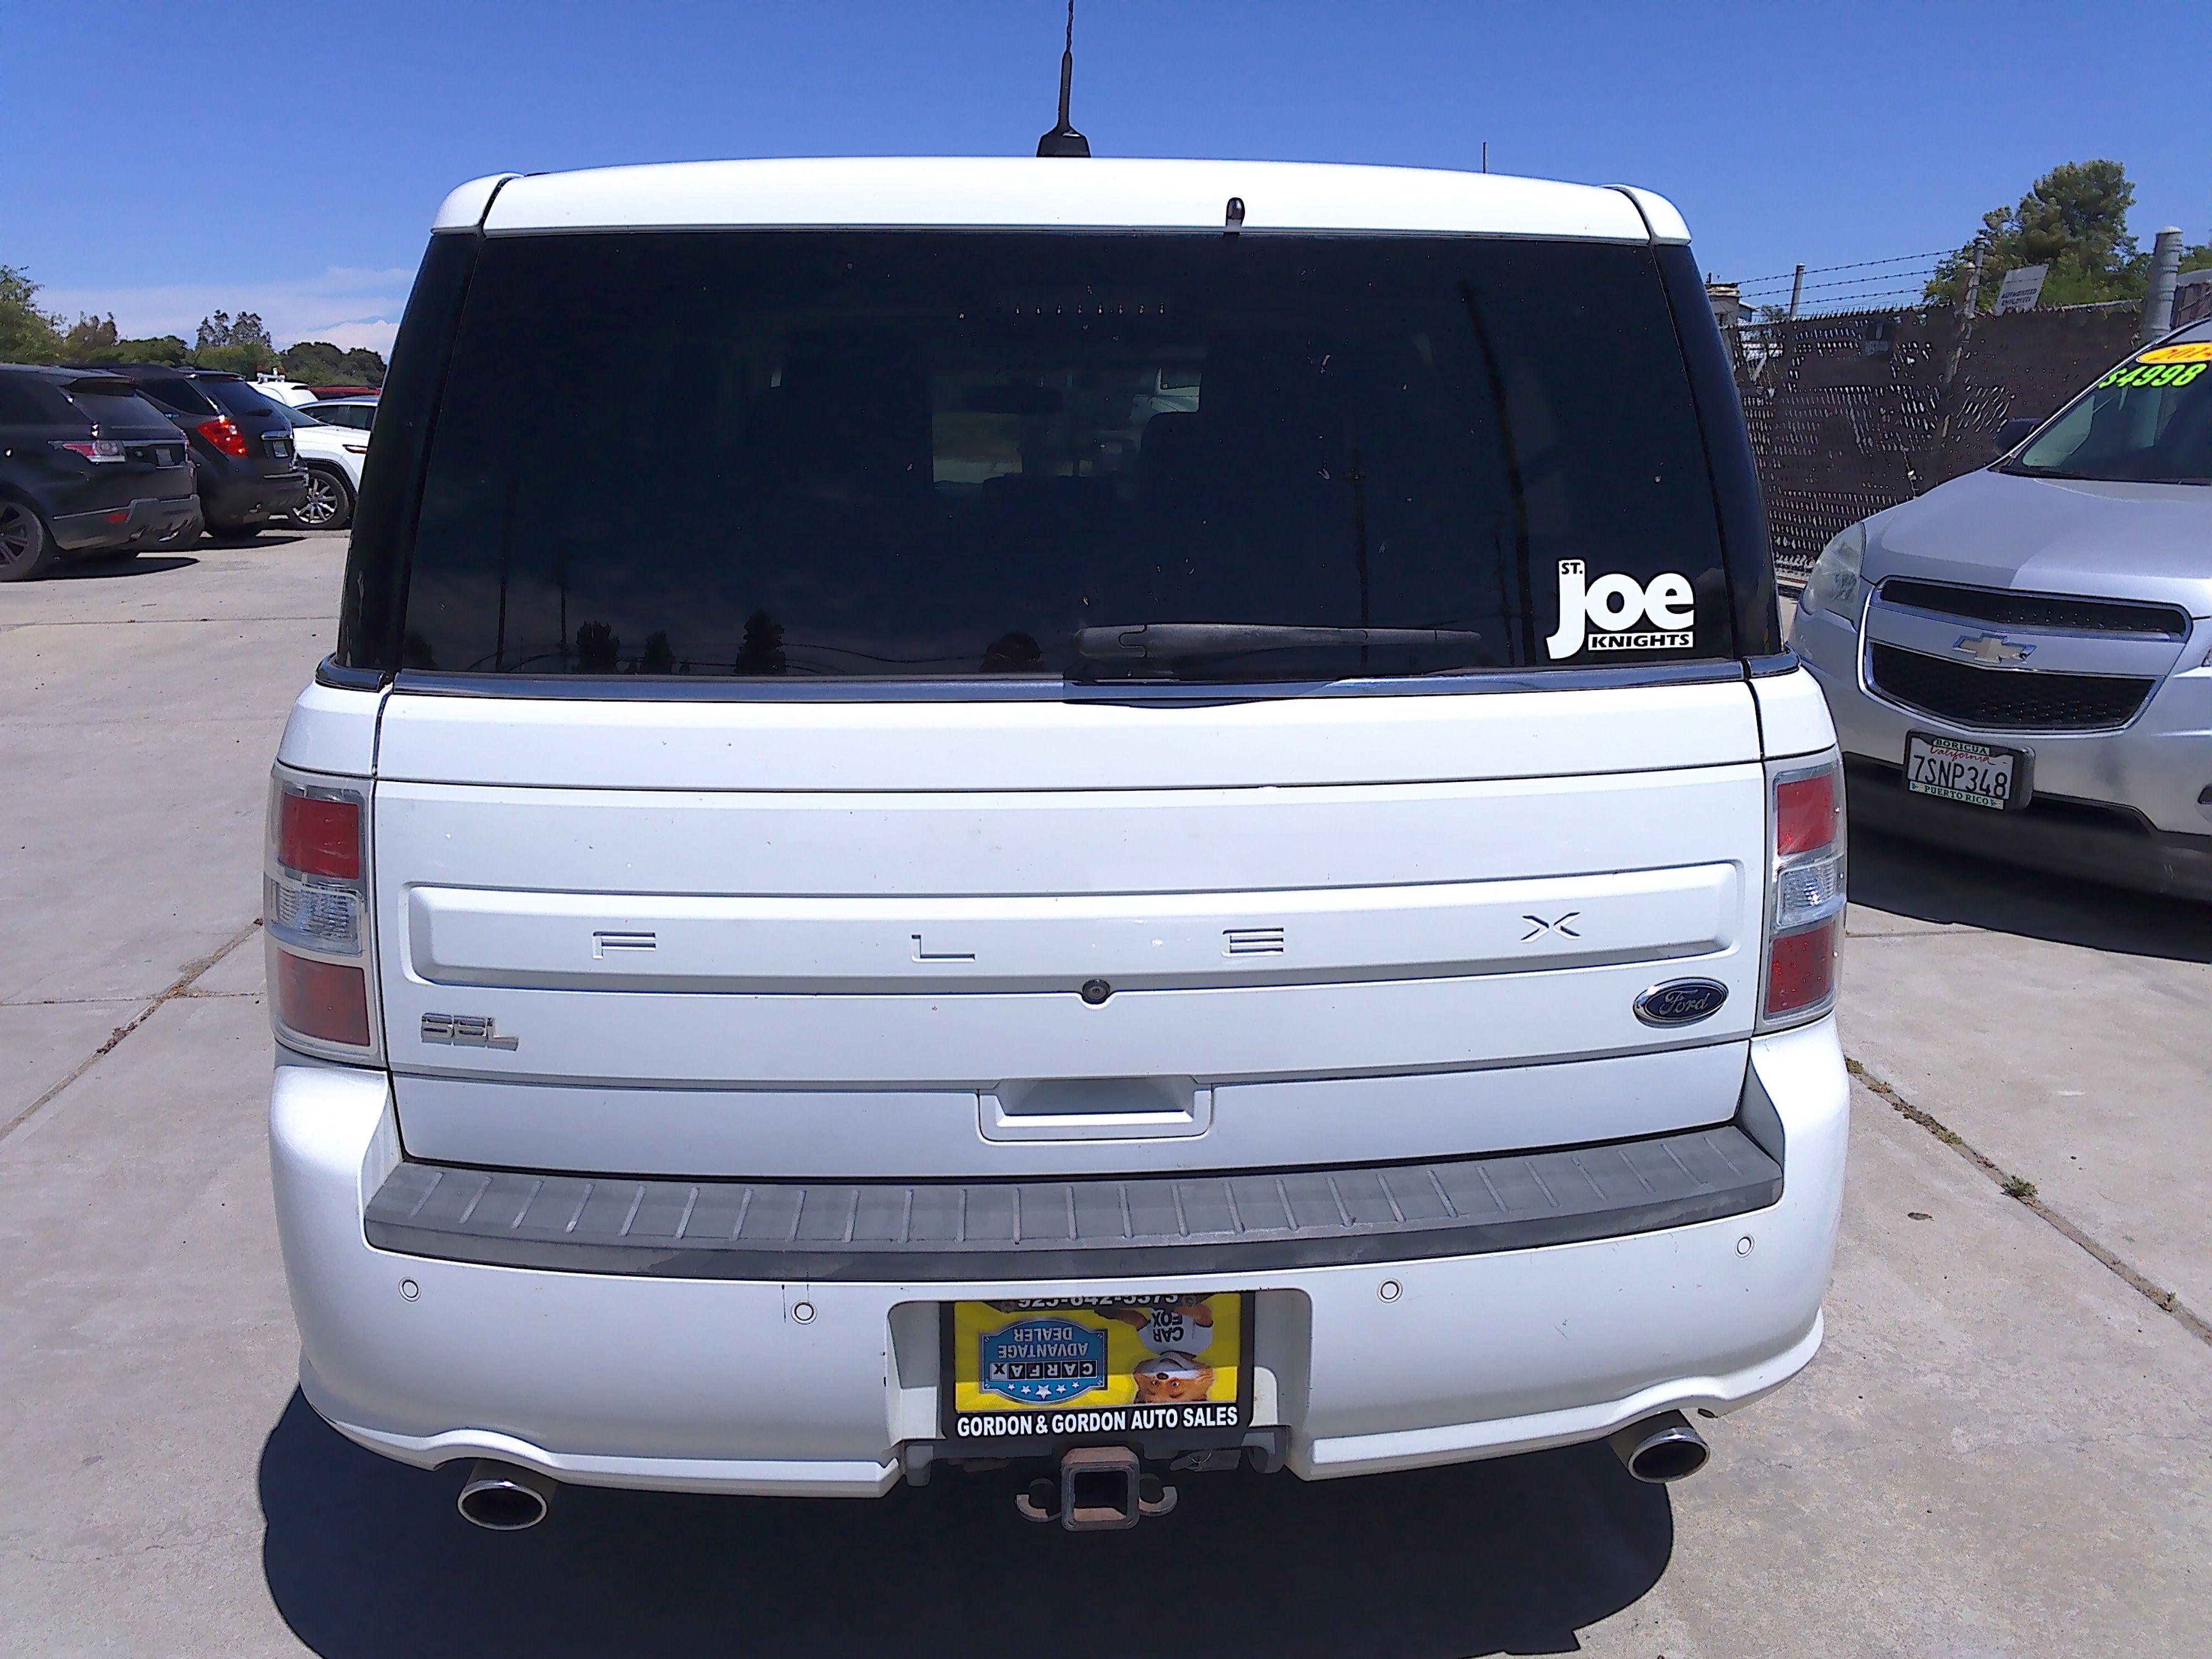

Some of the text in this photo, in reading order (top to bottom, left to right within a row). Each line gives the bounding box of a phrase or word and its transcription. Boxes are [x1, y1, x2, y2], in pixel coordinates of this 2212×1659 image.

[1561, 562, 1583, 575] ST.
[1592, 634, 1690, 648] KNIGHTS
[1930, 746, 1997, 764] California
[1936, 739, 1987, 755] BORICUA
[1913, 754, 2008, 798] 7SNP348
[1924, 785, 1989, 805] PUERTO RICO
[1660, 989, 1711, 1015] Ford
[421, 1012, 520, 1051] SEL
[1151, 1310, 1183, 1327] FOX
[1013, 1327, 1073, 1342] DEALER
[1152, 1326, 1184, 1343] CAR
[998, 1342, 1088, 1359] ADVANTAGE
[990, 1362, 1094, 1378] CARFAX
[957, 1406, 1238, 1437] GORDON & GORDON AUTO SALES
